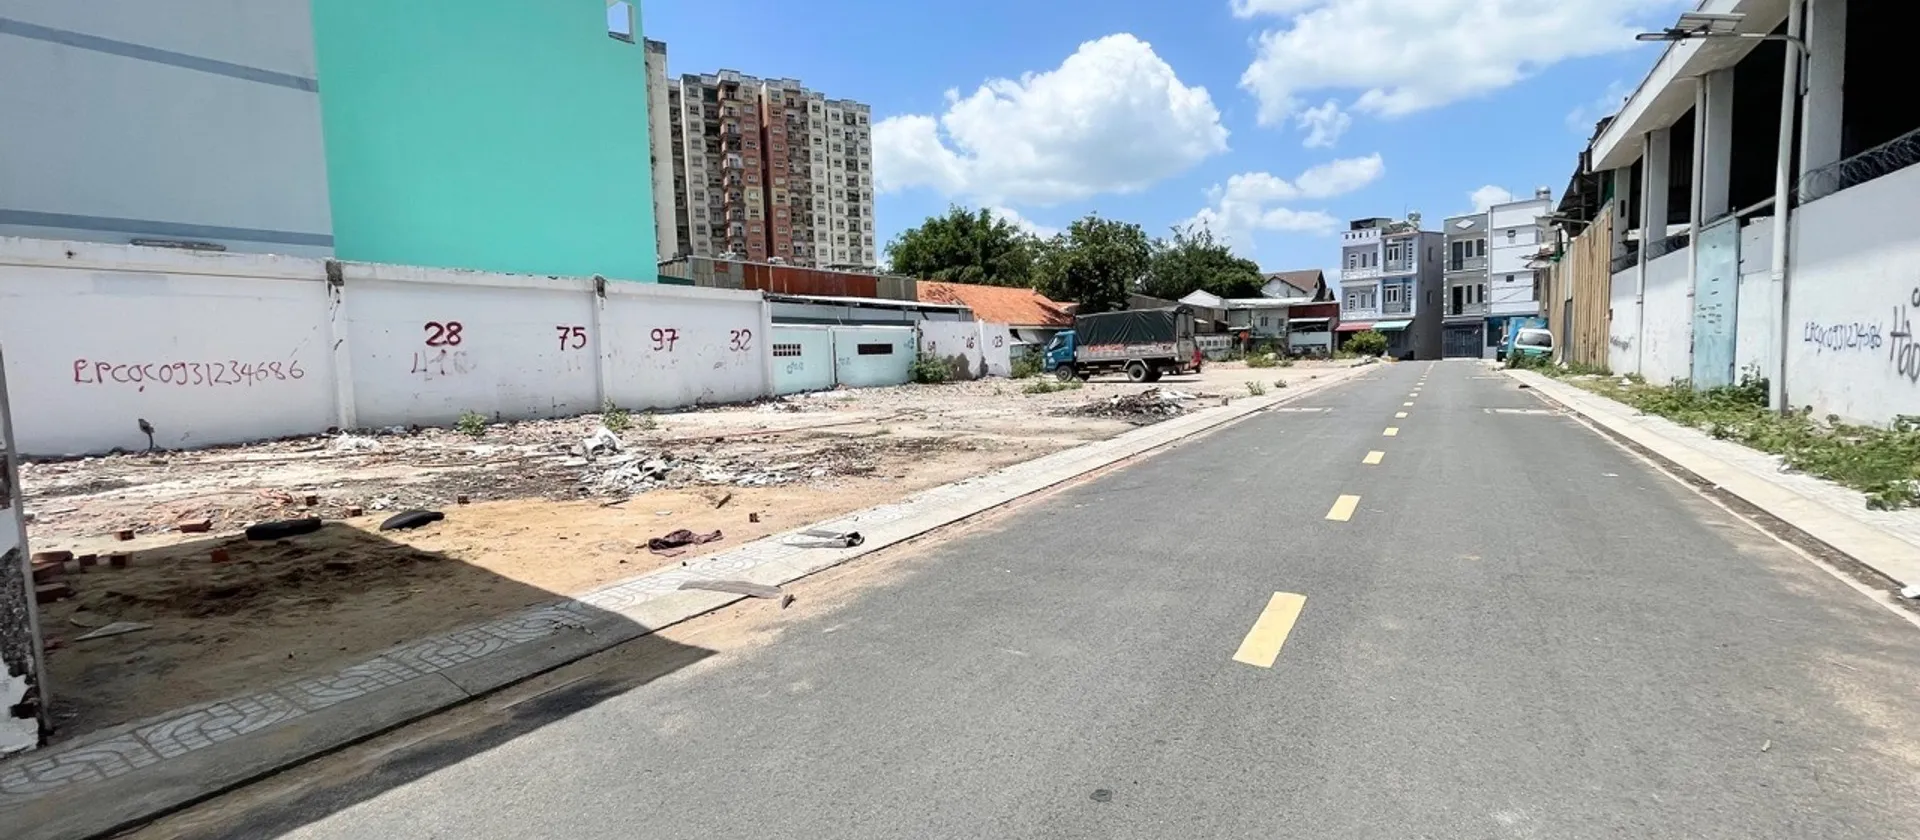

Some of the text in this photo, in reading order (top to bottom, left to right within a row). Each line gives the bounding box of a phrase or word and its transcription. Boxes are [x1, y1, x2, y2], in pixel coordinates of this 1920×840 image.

[424, 321, 463, 347] 28
[556, 325, 587, 351] 75
[650, 328, 679, 352] 97
[729, 329, 752, 352] 32
